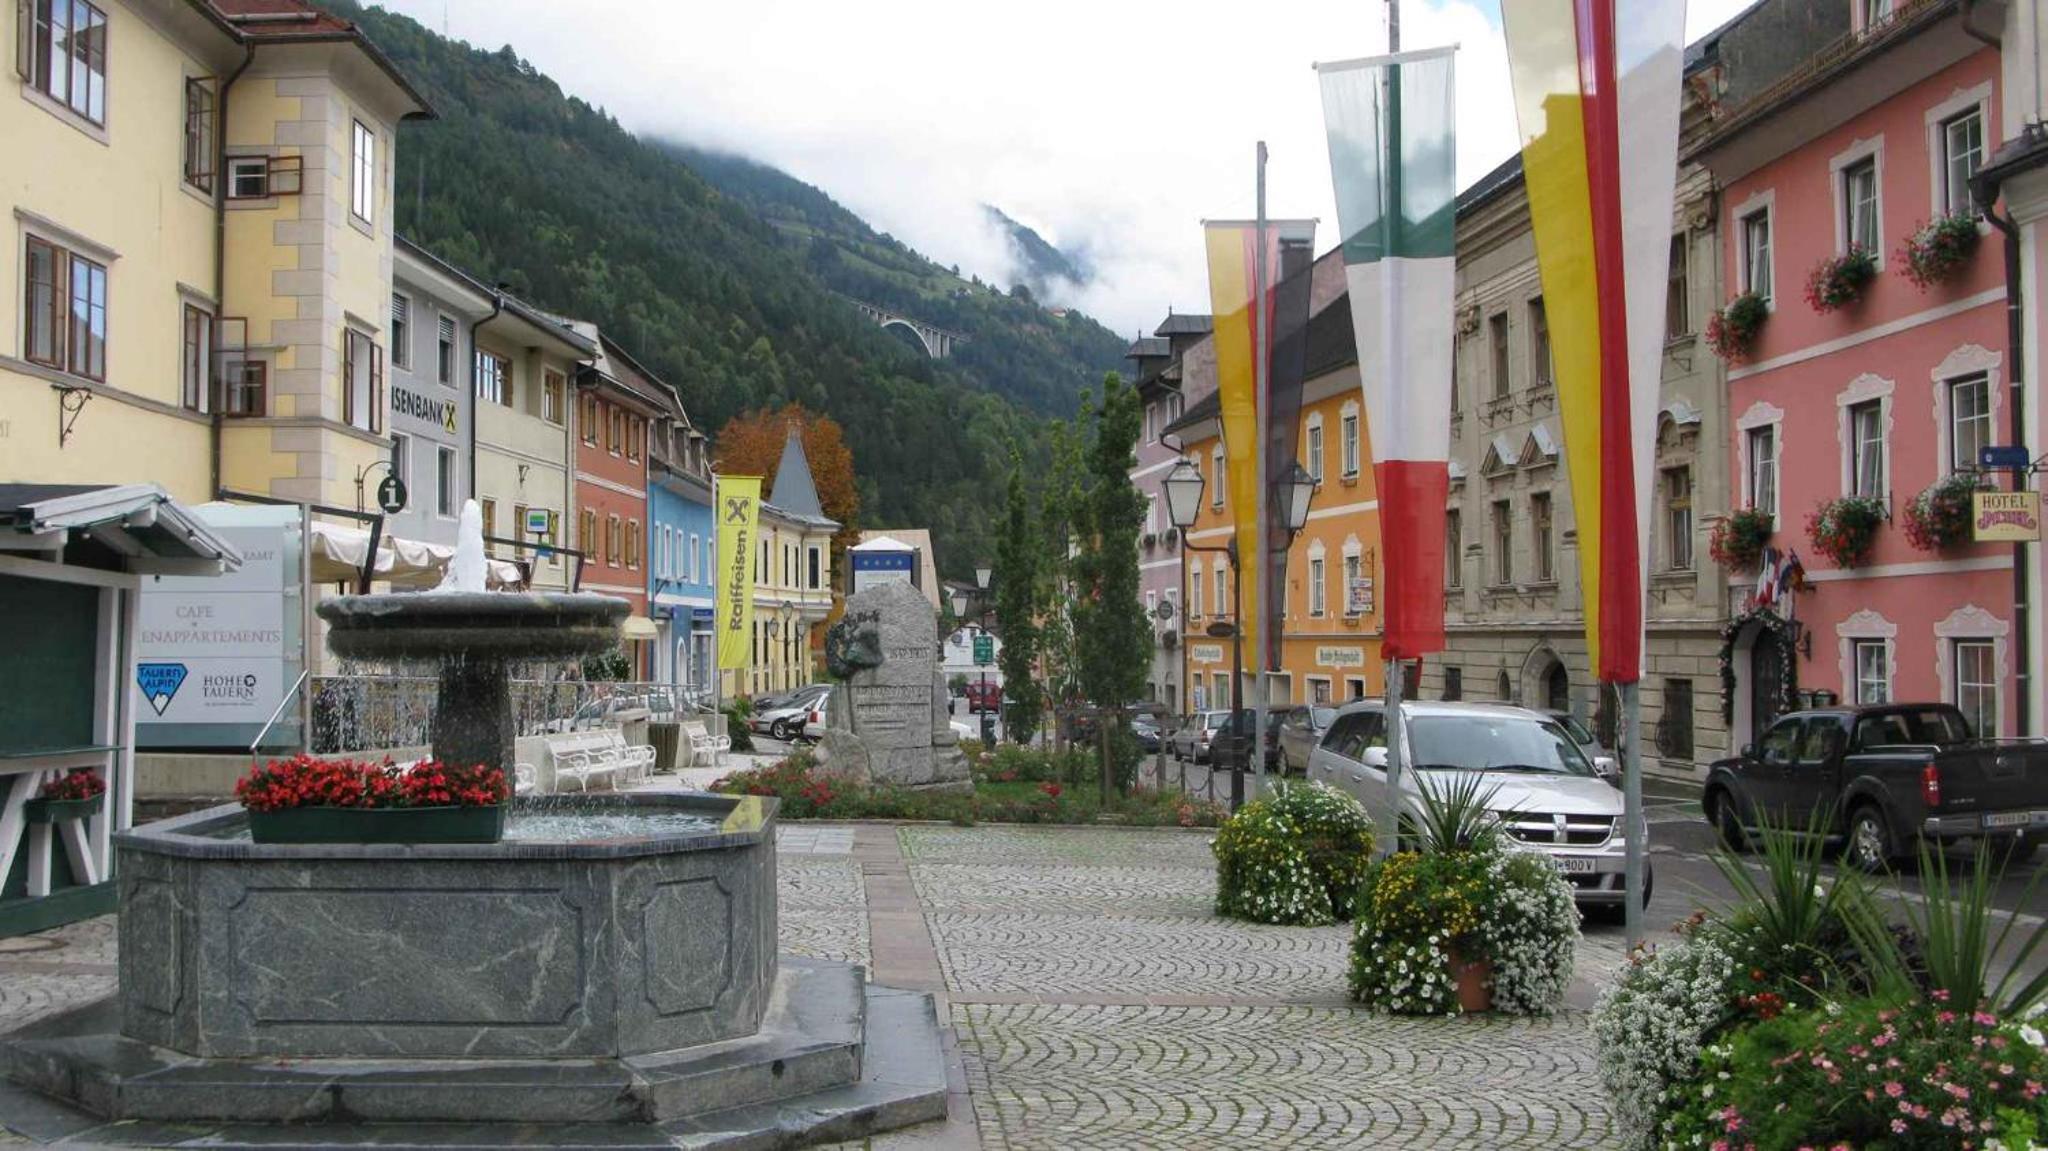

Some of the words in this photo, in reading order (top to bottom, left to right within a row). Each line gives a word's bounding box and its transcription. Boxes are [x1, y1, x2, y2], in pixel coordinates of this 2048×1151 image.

[1983, 495, 2028, 508] HOTEL
[729, 529, 748, 631] Raiffeisen
[204, 675, 242, 687] HOHE
[203, 687, 257, 699] TAUERN
